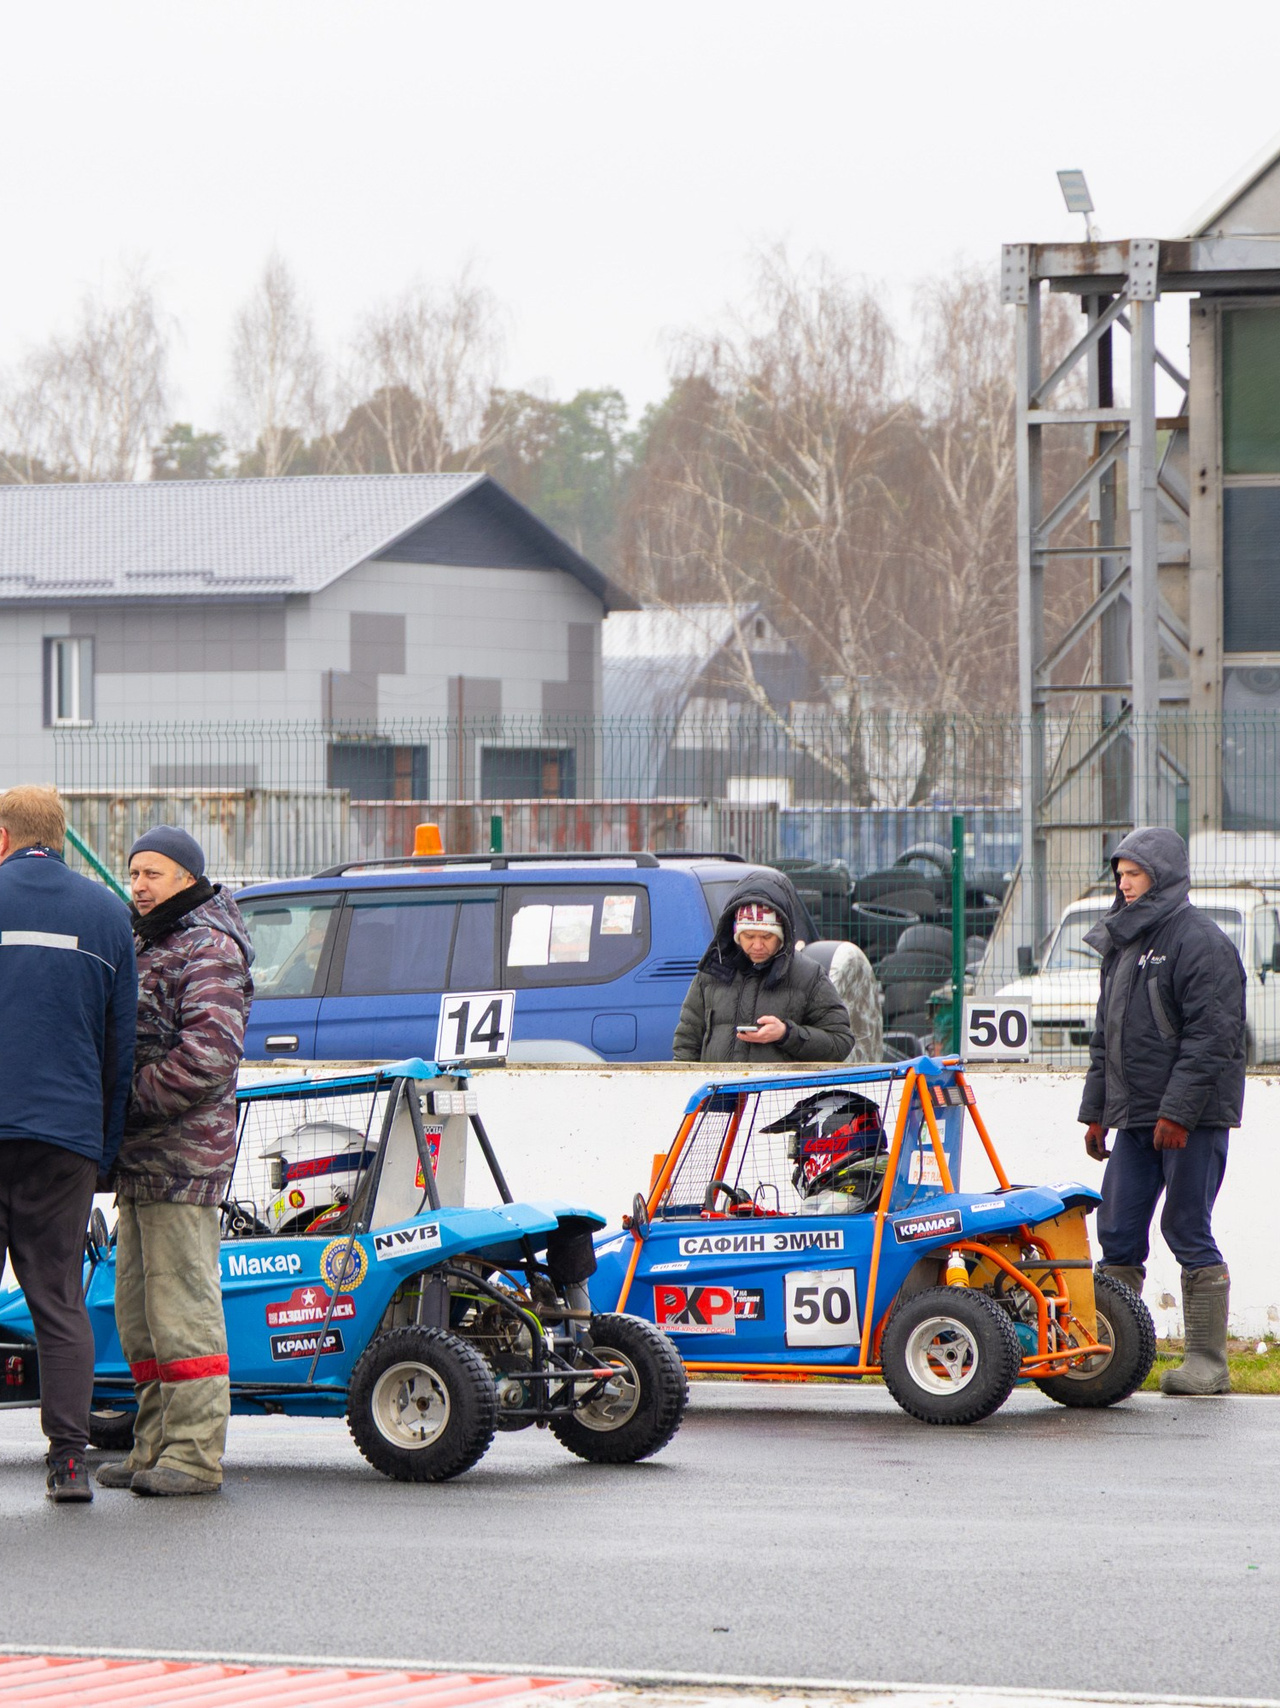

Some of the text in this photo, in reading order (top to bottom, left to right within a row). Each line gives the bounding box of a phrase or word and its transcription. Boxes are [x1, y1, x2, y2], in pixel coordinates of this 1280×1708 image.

[448, 999, 504, 1055] 14
[969, 1010, 1027, 1047] 50
[286, 1157, 336, 1180] LEATT
[375, 1225, 438, 1250] NWB
[900, 1217, 956, 1236] КРАМАР
[684, 1232, 839, 1254] САФИН ЭМИН
[228, 1253, 302, 1276] Макар
[793, 1287, 851, 1325] 50
